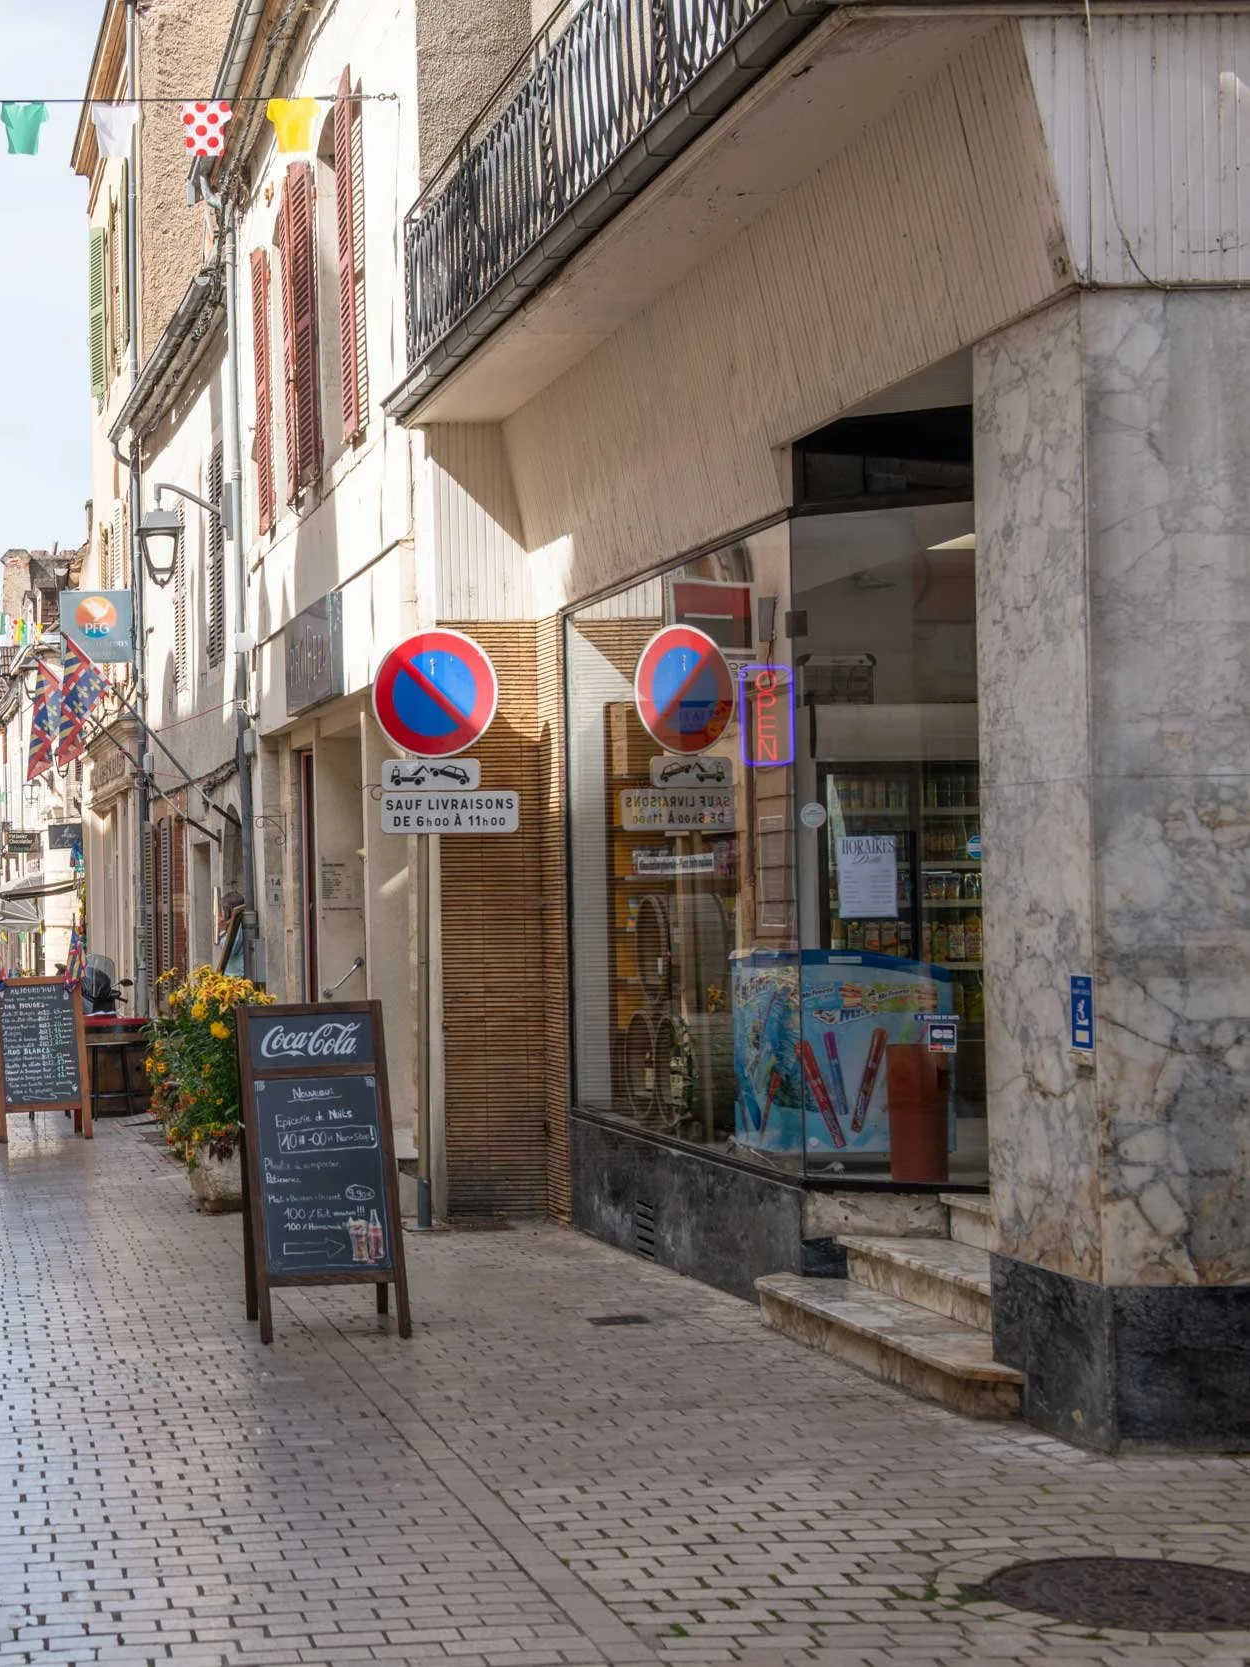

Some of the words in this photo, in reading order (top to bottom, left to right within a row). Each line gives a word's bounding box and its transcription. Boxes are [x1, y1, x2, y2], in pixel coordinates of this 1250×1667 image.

[85, 622, 110, 634] PFG
[755, 671, 778, 761] OPEN
[386, 799, 422, 811] SAUF
[428, 798, 514, 810] LIVRAISONS
[393, 816, 411, 827] DE
[416, 816, 450, 827] 6h00
[454, 813, 463, 827] À
[468, 816, 506, 827] 11h00
[842, 839, 896, 855] HORAIRES
[315, 1112, 325, 1122] de
[328, 1109, 354, 1120] Nuits
